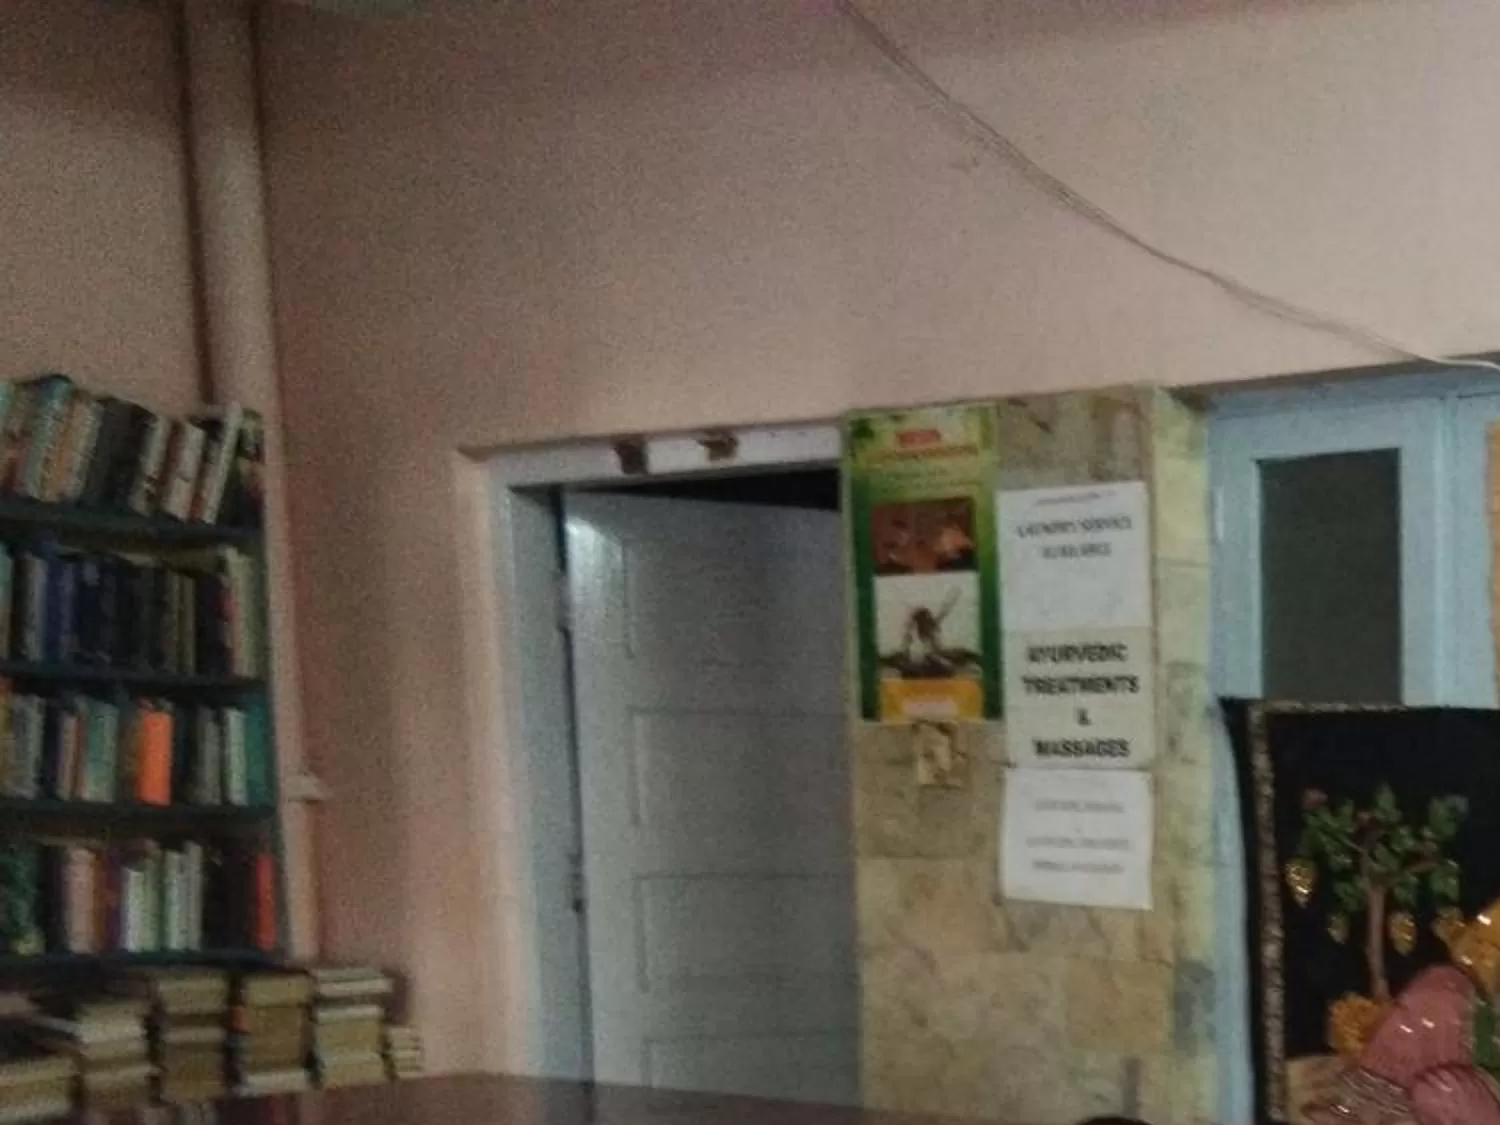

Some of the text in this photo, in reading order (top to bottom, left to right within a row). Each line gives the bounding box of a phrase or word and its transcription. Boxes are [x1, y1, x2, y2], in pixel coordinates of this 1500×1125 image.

[1026, 644, 1128, 662] AYURVEDIC
[1022, 675, 1139, 694] TREATMENTS
[1033, 739, 1131, 757] MASSAGES
